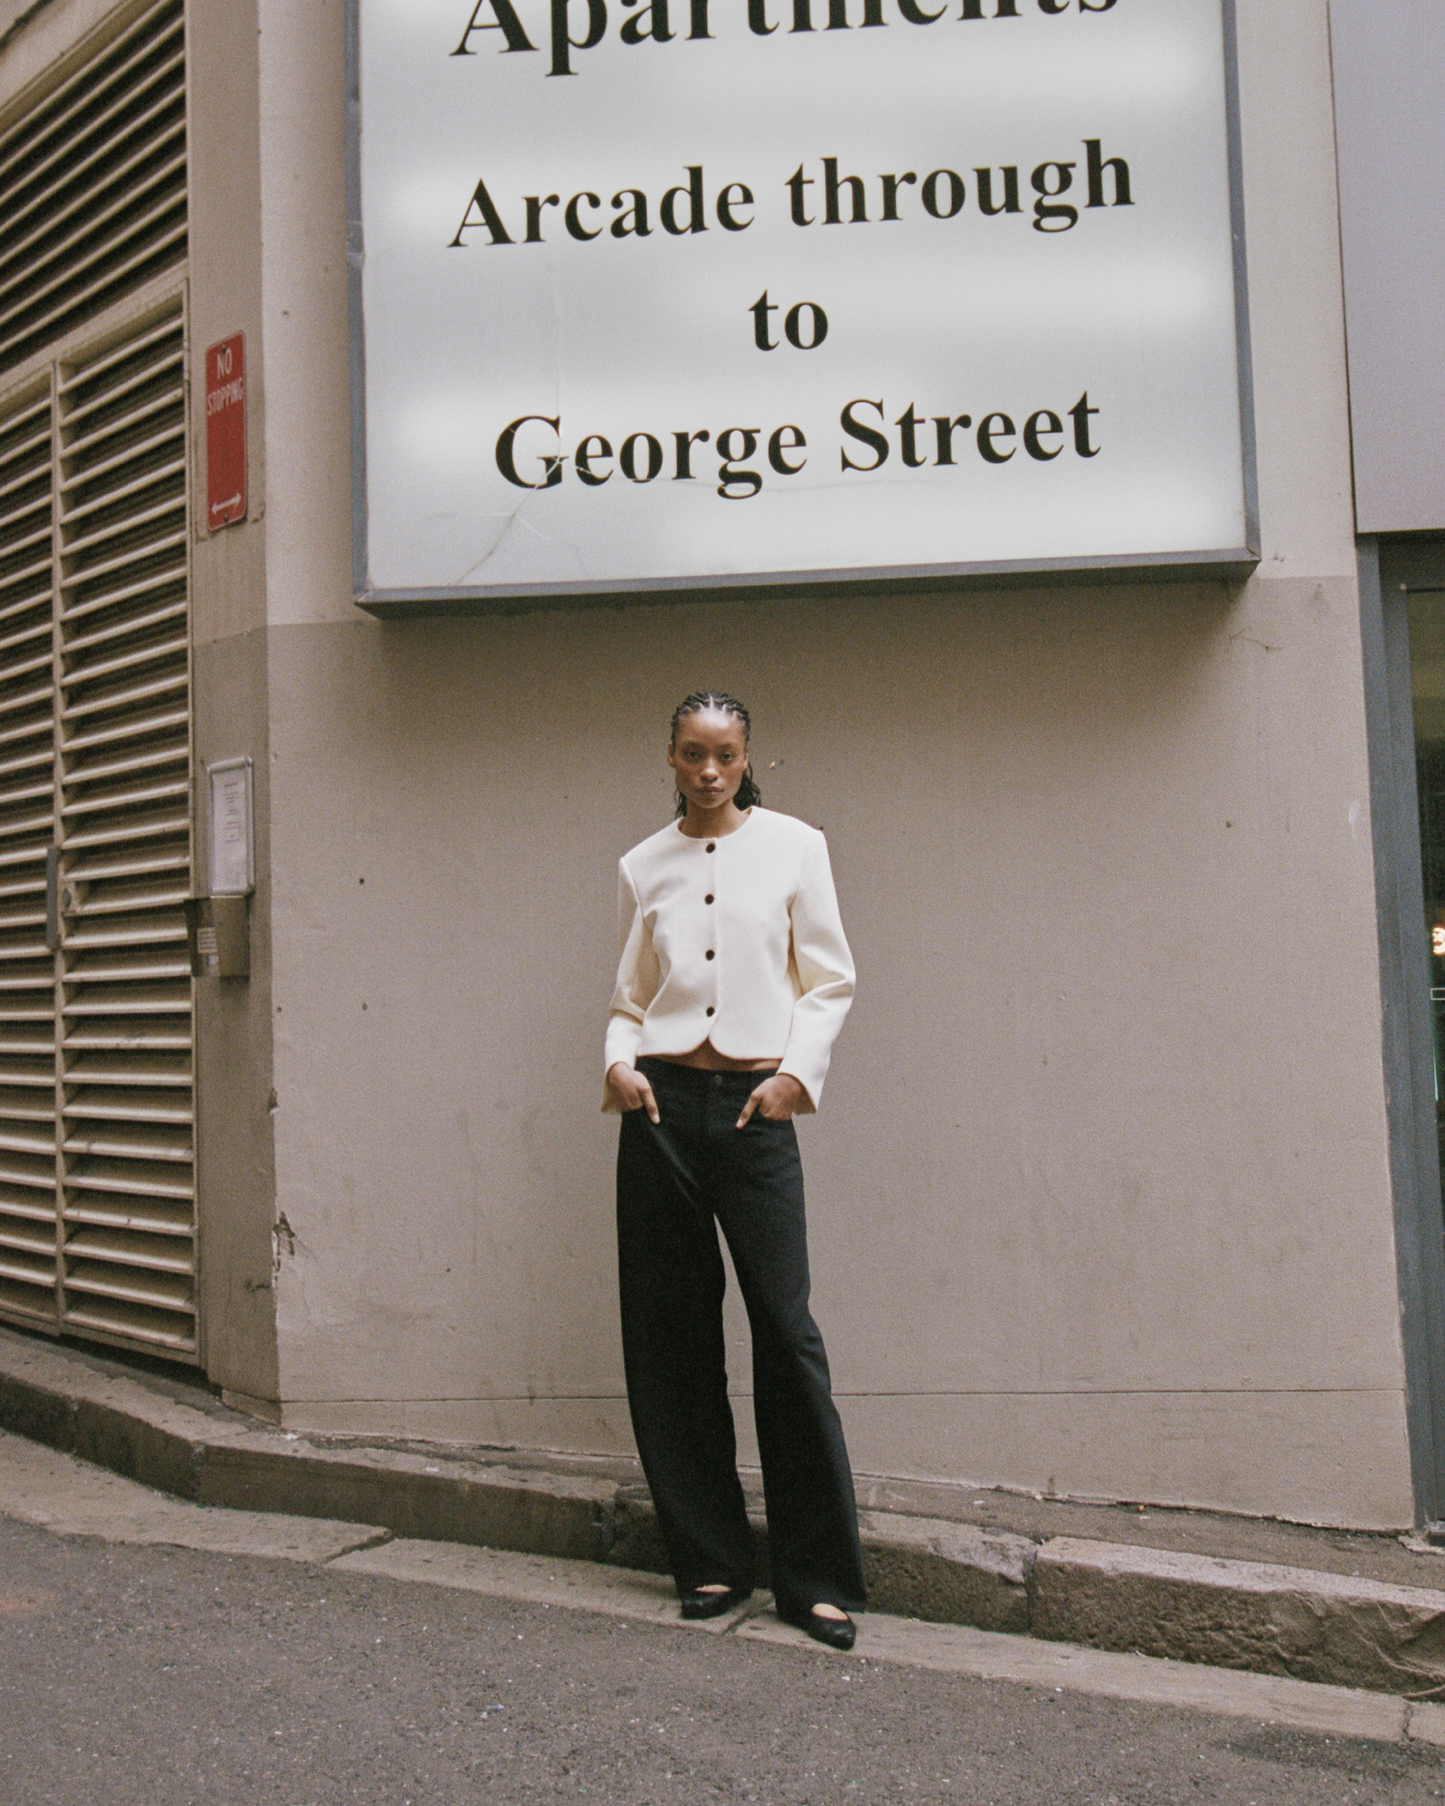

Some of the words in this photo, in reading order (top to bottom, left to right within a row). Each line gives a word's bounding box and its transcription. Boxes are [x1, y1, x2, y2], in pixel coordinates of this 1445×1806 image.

[448, 0, 1118, 77] Aparm
[448, 166, 755, 248] Arcade
[785, 139, 1135, 233] through
[749, 290, 829, 352] to
[207, 376, 243, 416] STOPPING
[217, 347, 232, 380] NO
[495, 415, 808, 500] George
[840, 391, 1101, 473] Street
